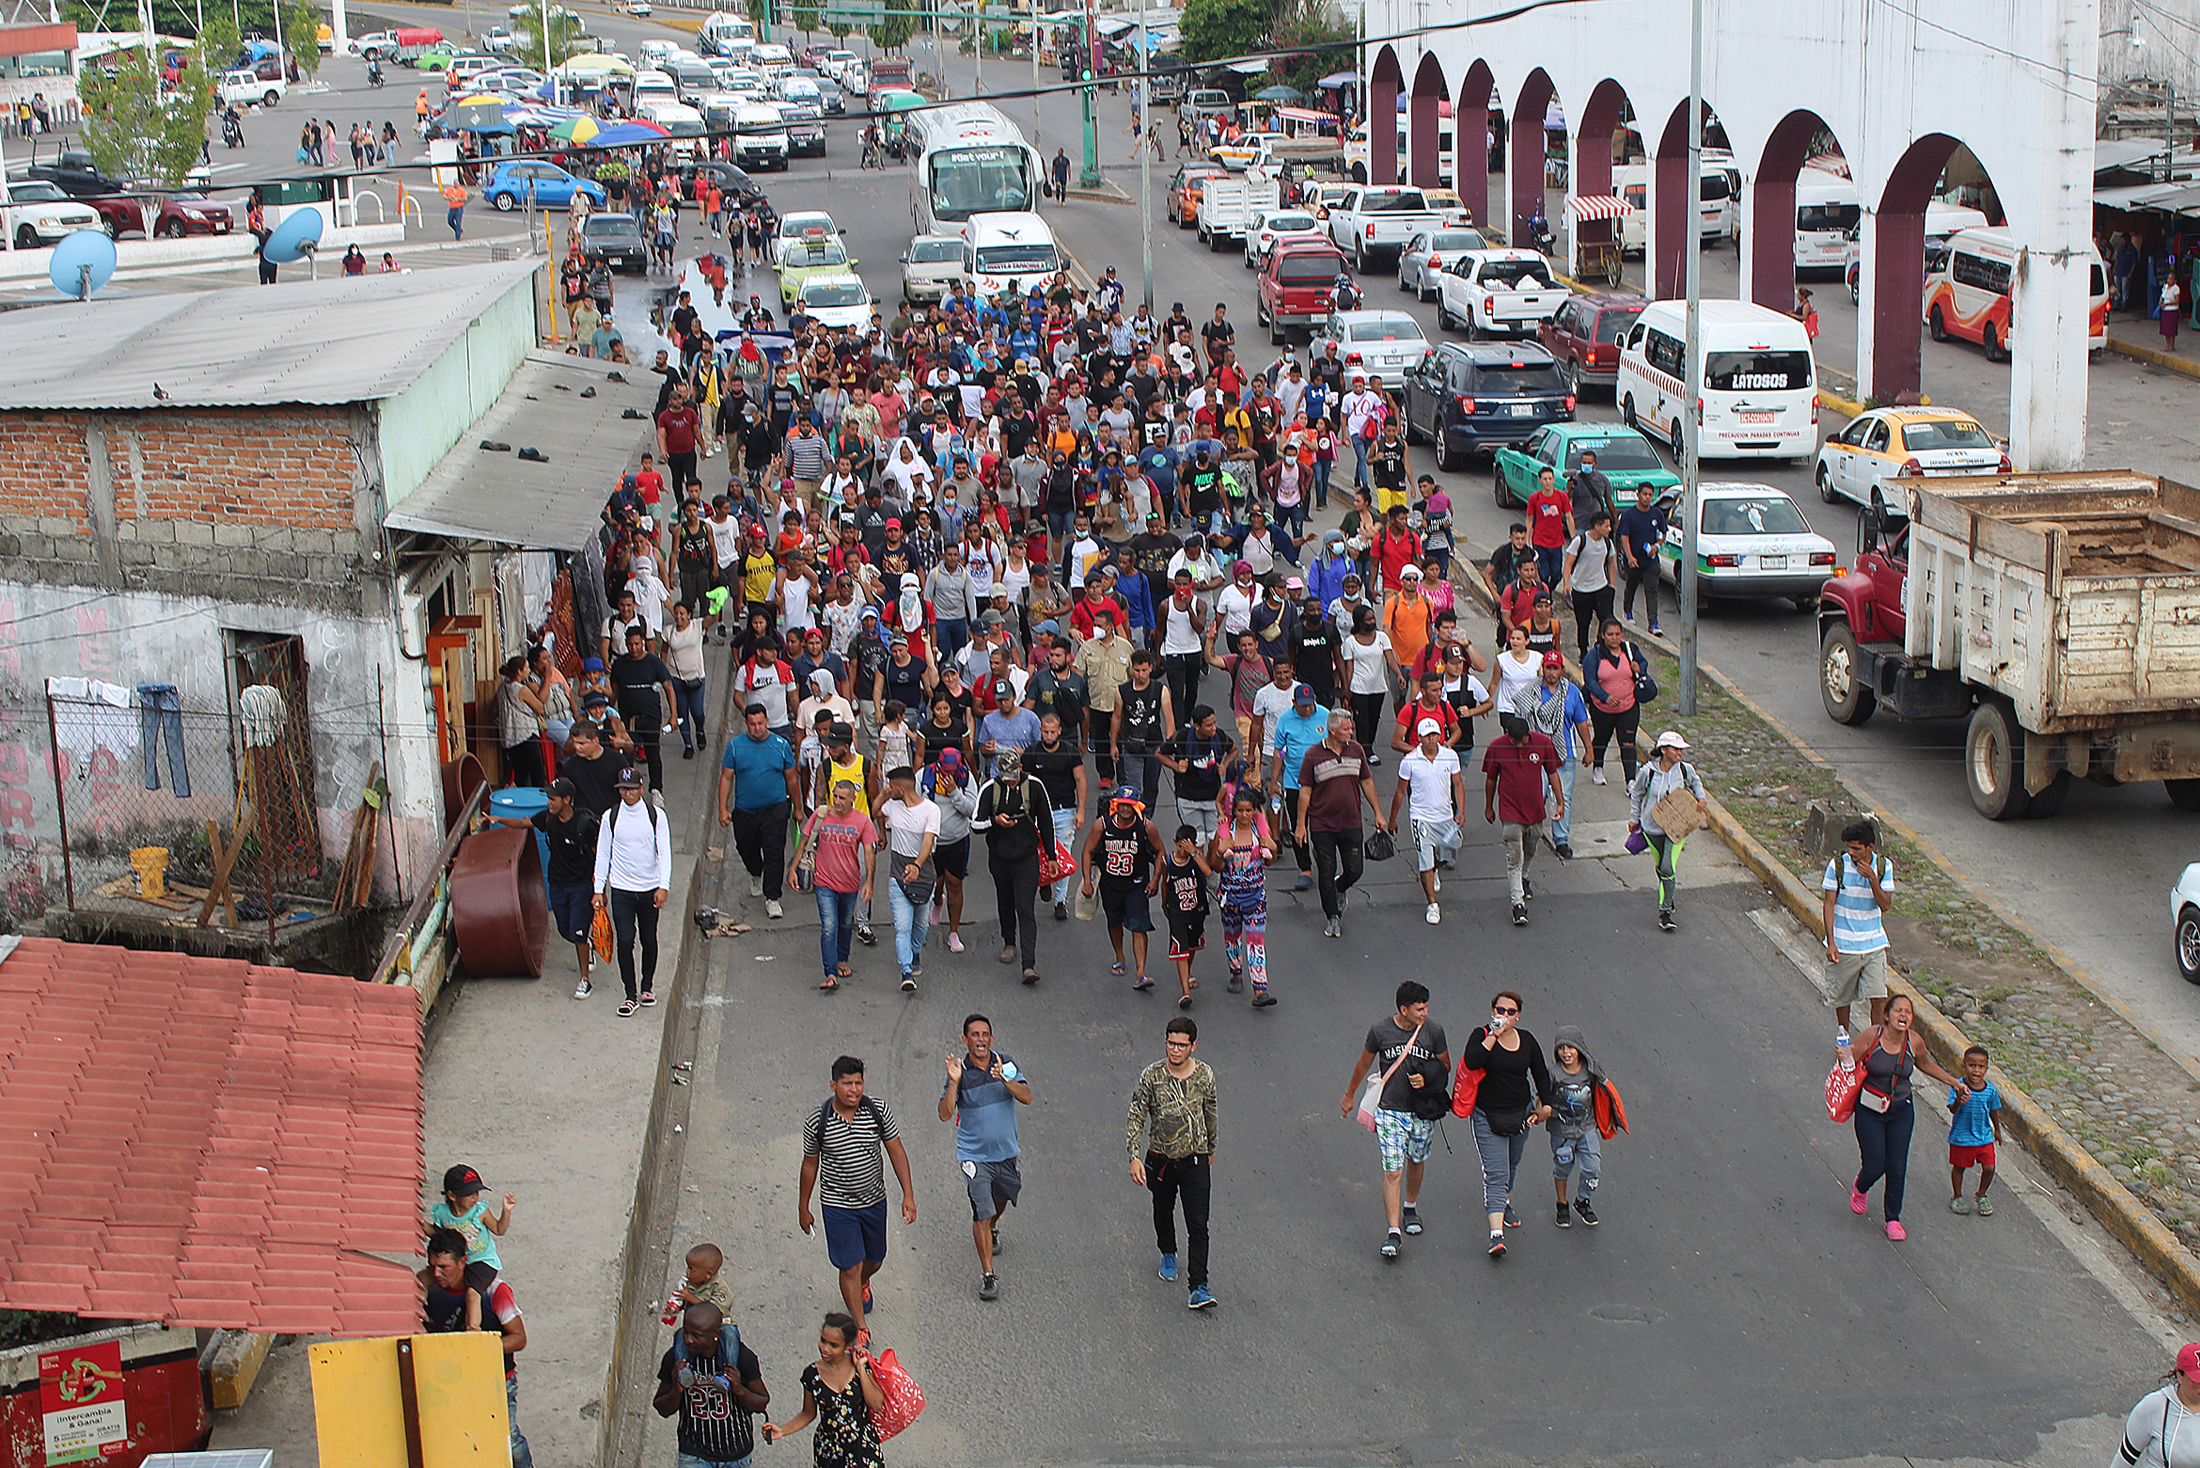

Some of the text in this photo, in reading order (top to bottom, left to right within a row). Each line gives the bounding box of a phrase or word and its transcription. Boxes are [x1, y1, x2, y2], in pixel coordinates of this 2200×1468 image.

[1732, 373, 1788, 389] LATOSOS
[1387, 460, 1395, 472] 11
[1194, 472, 1215, 486] NIKE
[755, 676, 774, 687] NIKE
[1302, 687, 1310, 696] C
[819, 824, 858, 836] STAR
[819, 834, 857, 845] WARS
[1105, 839, 1138, 854] BULLS
[1107, 853, 1133, 876] 23
[1179, 890, 1198, 912] 23
[688, 1385, 731, 1420] 23
